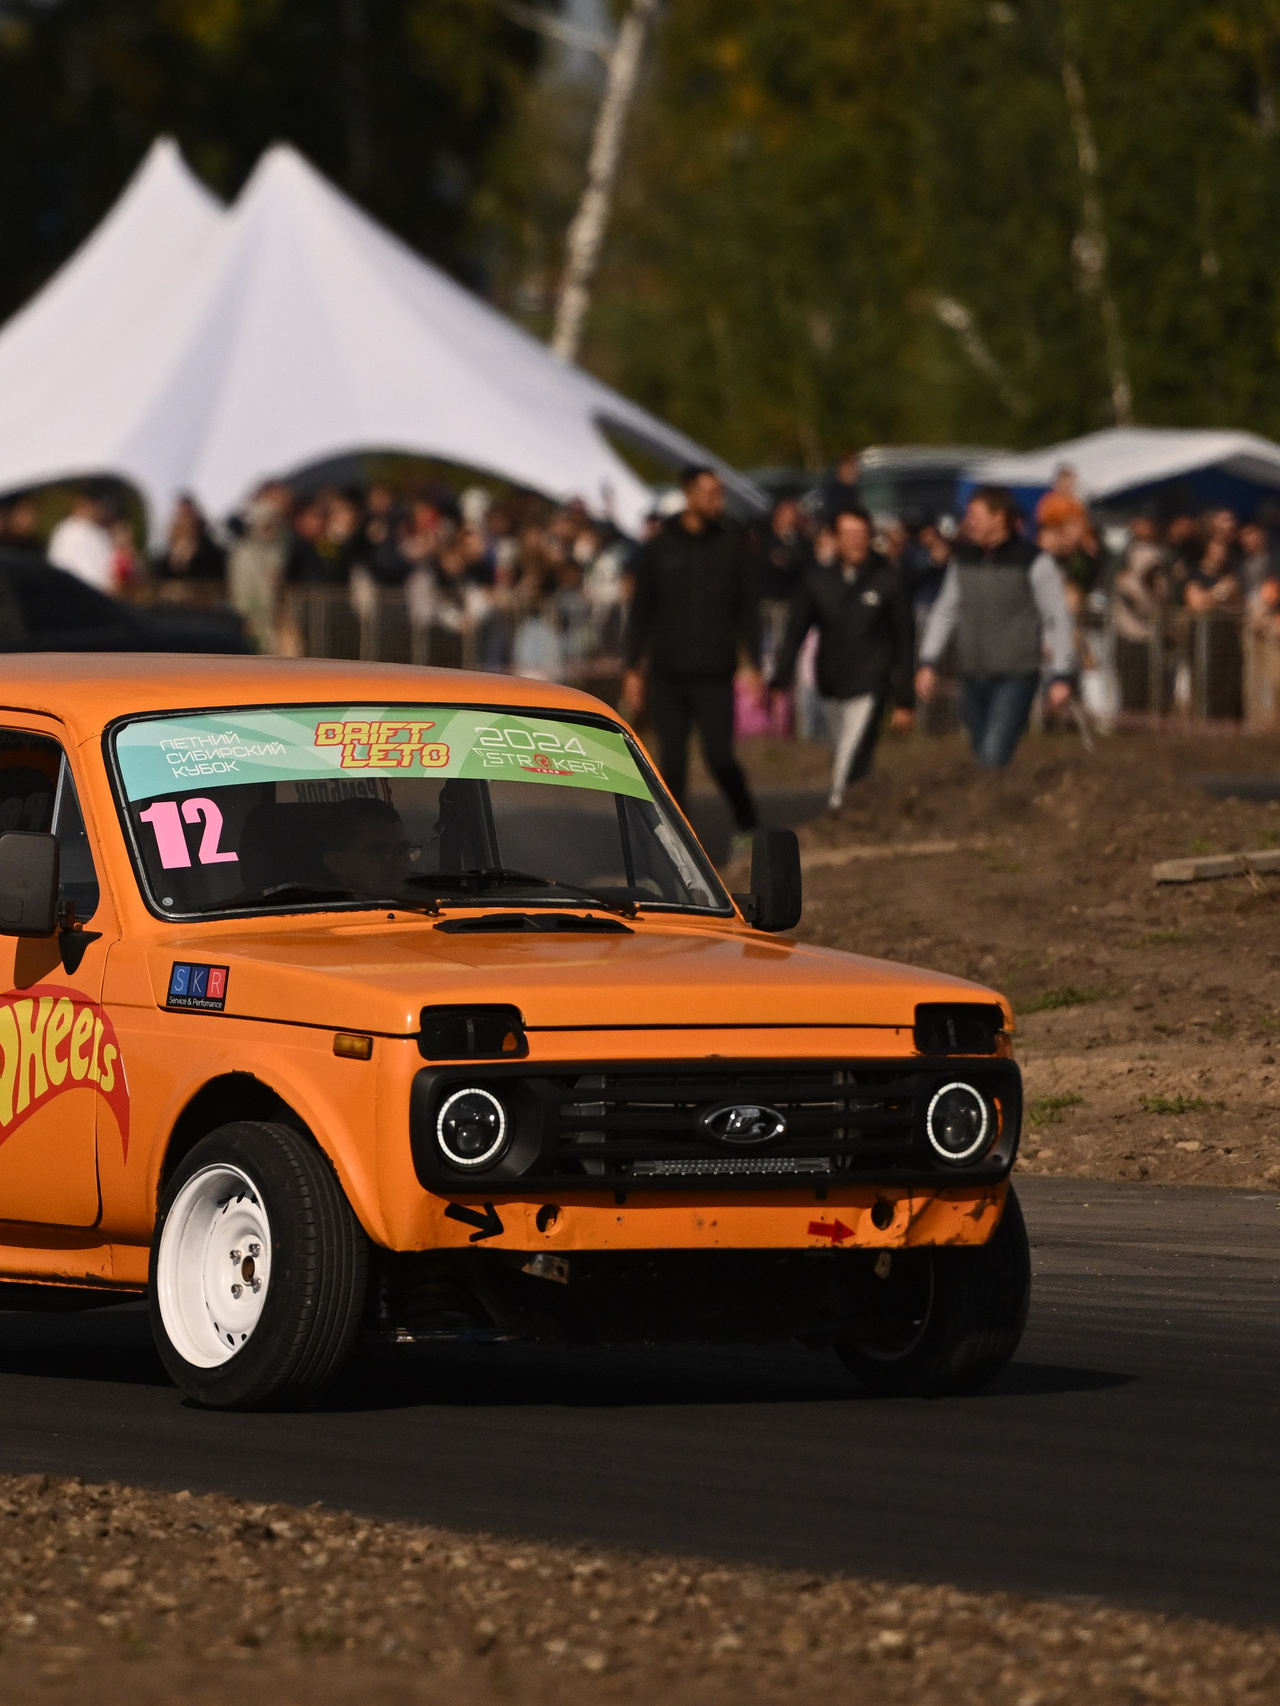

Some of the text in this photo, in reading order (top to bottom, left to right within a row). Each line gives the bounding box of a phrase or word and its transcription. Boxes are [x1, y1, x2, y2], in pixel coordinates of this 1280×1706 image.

[159, 730, 241, 751] ЛЕТНИЙ
[314, 720, 436, 746] DRIFT
[474, 727, 587, 757] 2024
[166, 741, 286, 765] СИБИРСКИЙ
[340, 742, 450, 768] LETO
[172, 760, 240, 778] КУБОК
[139, 797, 238, 870] 12
[174, 968, 222, 995] SKR
[169, 996, 187, 1006] Service
